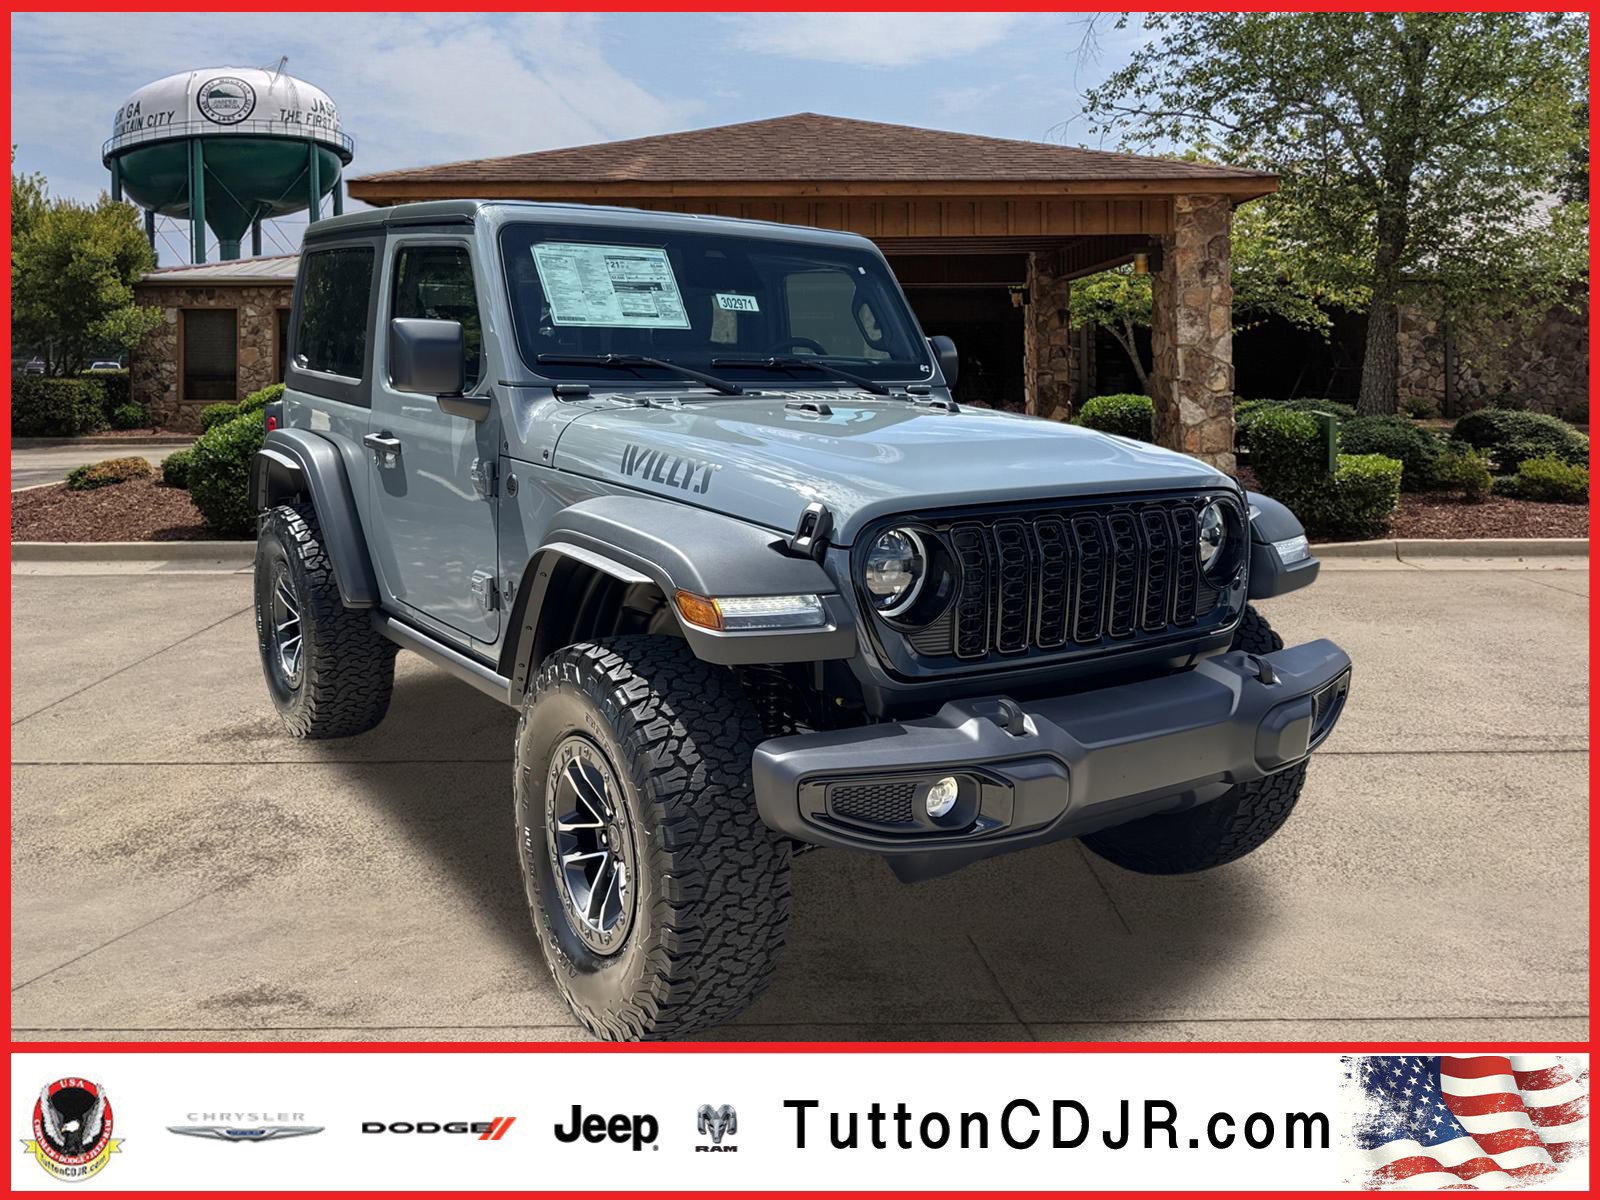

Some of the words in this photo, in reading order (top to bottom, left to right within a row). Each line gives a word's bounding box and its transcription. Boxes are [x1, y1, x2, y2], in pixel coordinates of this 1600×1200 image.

[126, 101, 141, 119] GA
[147, 110, 176, 127] CITY
[280, 109, 302, 124] THE
[306, 112, 332, 129] FIRST
[721, 297, 754, 309] 302971
[620, 444, 722, 494] WILLYS
